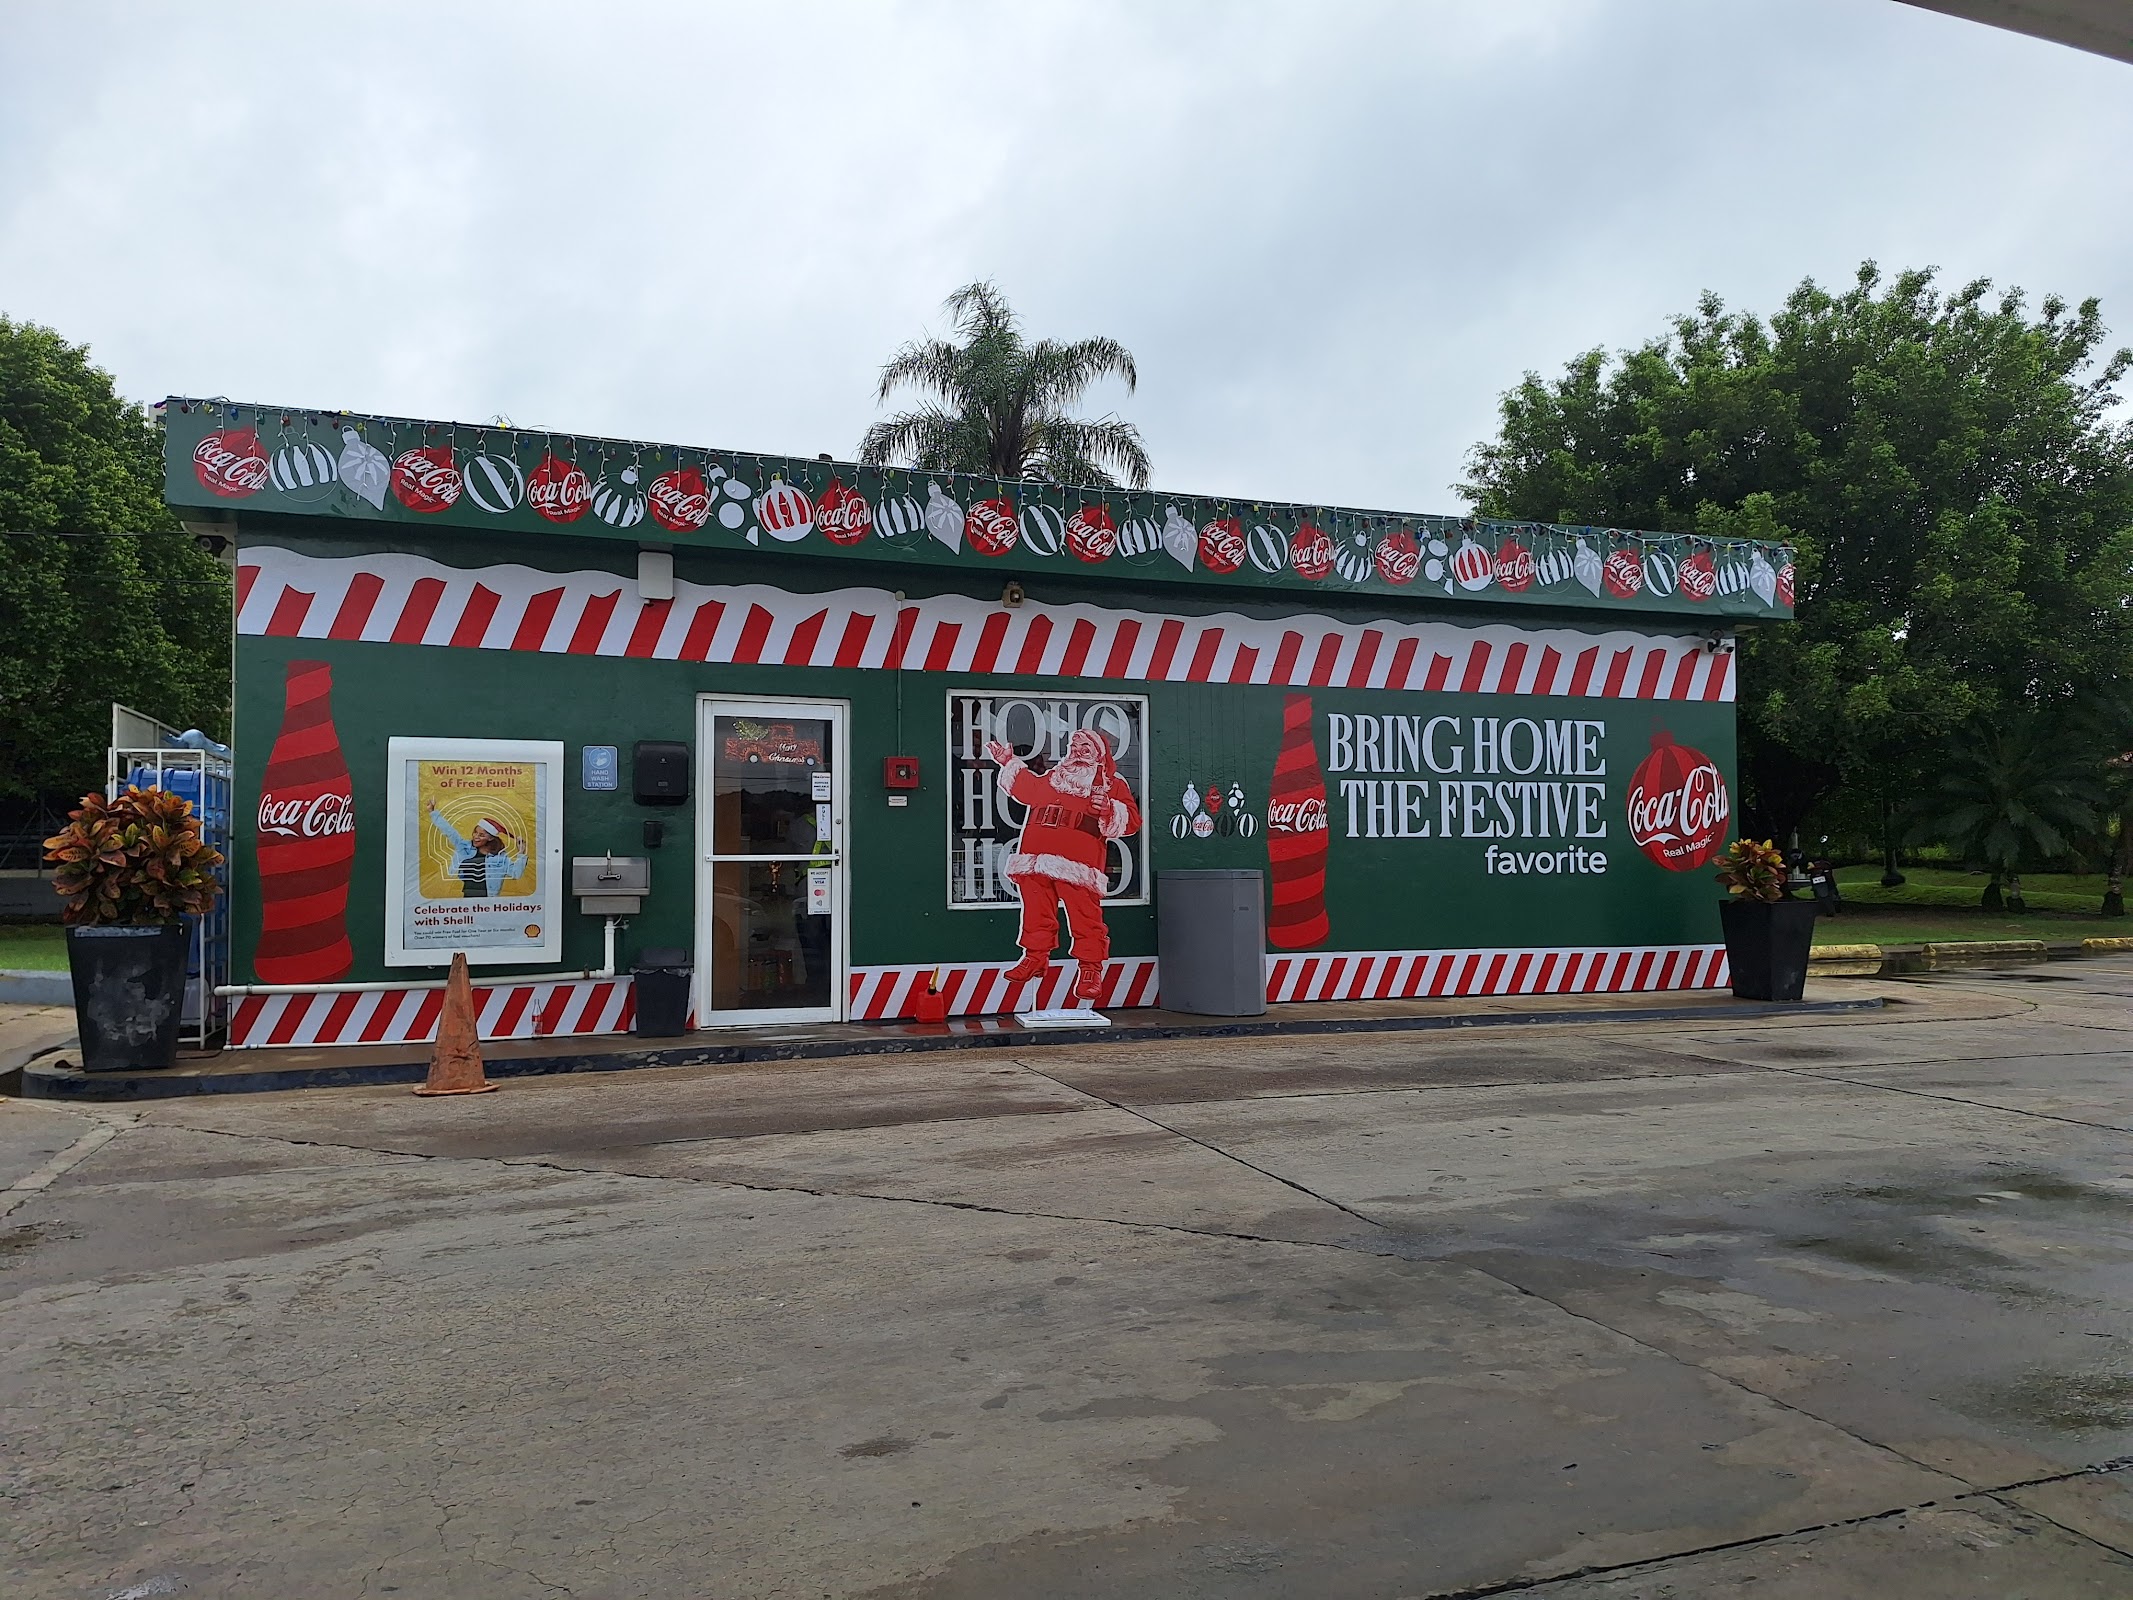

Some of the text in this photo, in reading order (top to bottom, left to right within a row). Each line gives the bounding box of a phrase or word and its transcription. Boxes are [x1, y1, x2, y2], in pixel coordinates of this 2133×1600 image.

[192, 437, 268, 490] Coca-Cola
[203, 472, 218, 484] Real
[392, 449, 462, 506] Coca-Cola
[400, 479, 414, 490] Real
[527, 470, 592, 509] Coca-Cola
[648, 477, 710, 527] Coca-Cola
[657, 509, 669, 520] Real
[816, 496, 872, 533] Coca-Cola
[966, 501, 1019, 550] Coca-Cola
[1066, 513, 1116, 556] Coca-Cola
[1199, 521, 1246, 568] Coca-Cola
[1290, 536, 1336, 569] Coca-Cola
[1375, 539, 1420, 579] Coca-Cola
[1327, 713, 1606, 776] BRING HOME
[432, 765, 523, 775] Win 12 Months
[440, 778, 515, 788] of Free Fuel!
[258, 793, 355, 837] Coca-Cola
[1268, 798, 1329, 832] Coca-Cola
[1340, 779, 1607, 839] THE FESTIVE
[1628, 762, 1729, 846] Coca-Cola
[1485, 844, 1608, 875] favorite
[1663, 848, 1685, 858] Real
[414, 902, 542, 915] Celebrate the Holidays
[414, 916, 474, 926] with Shell!
